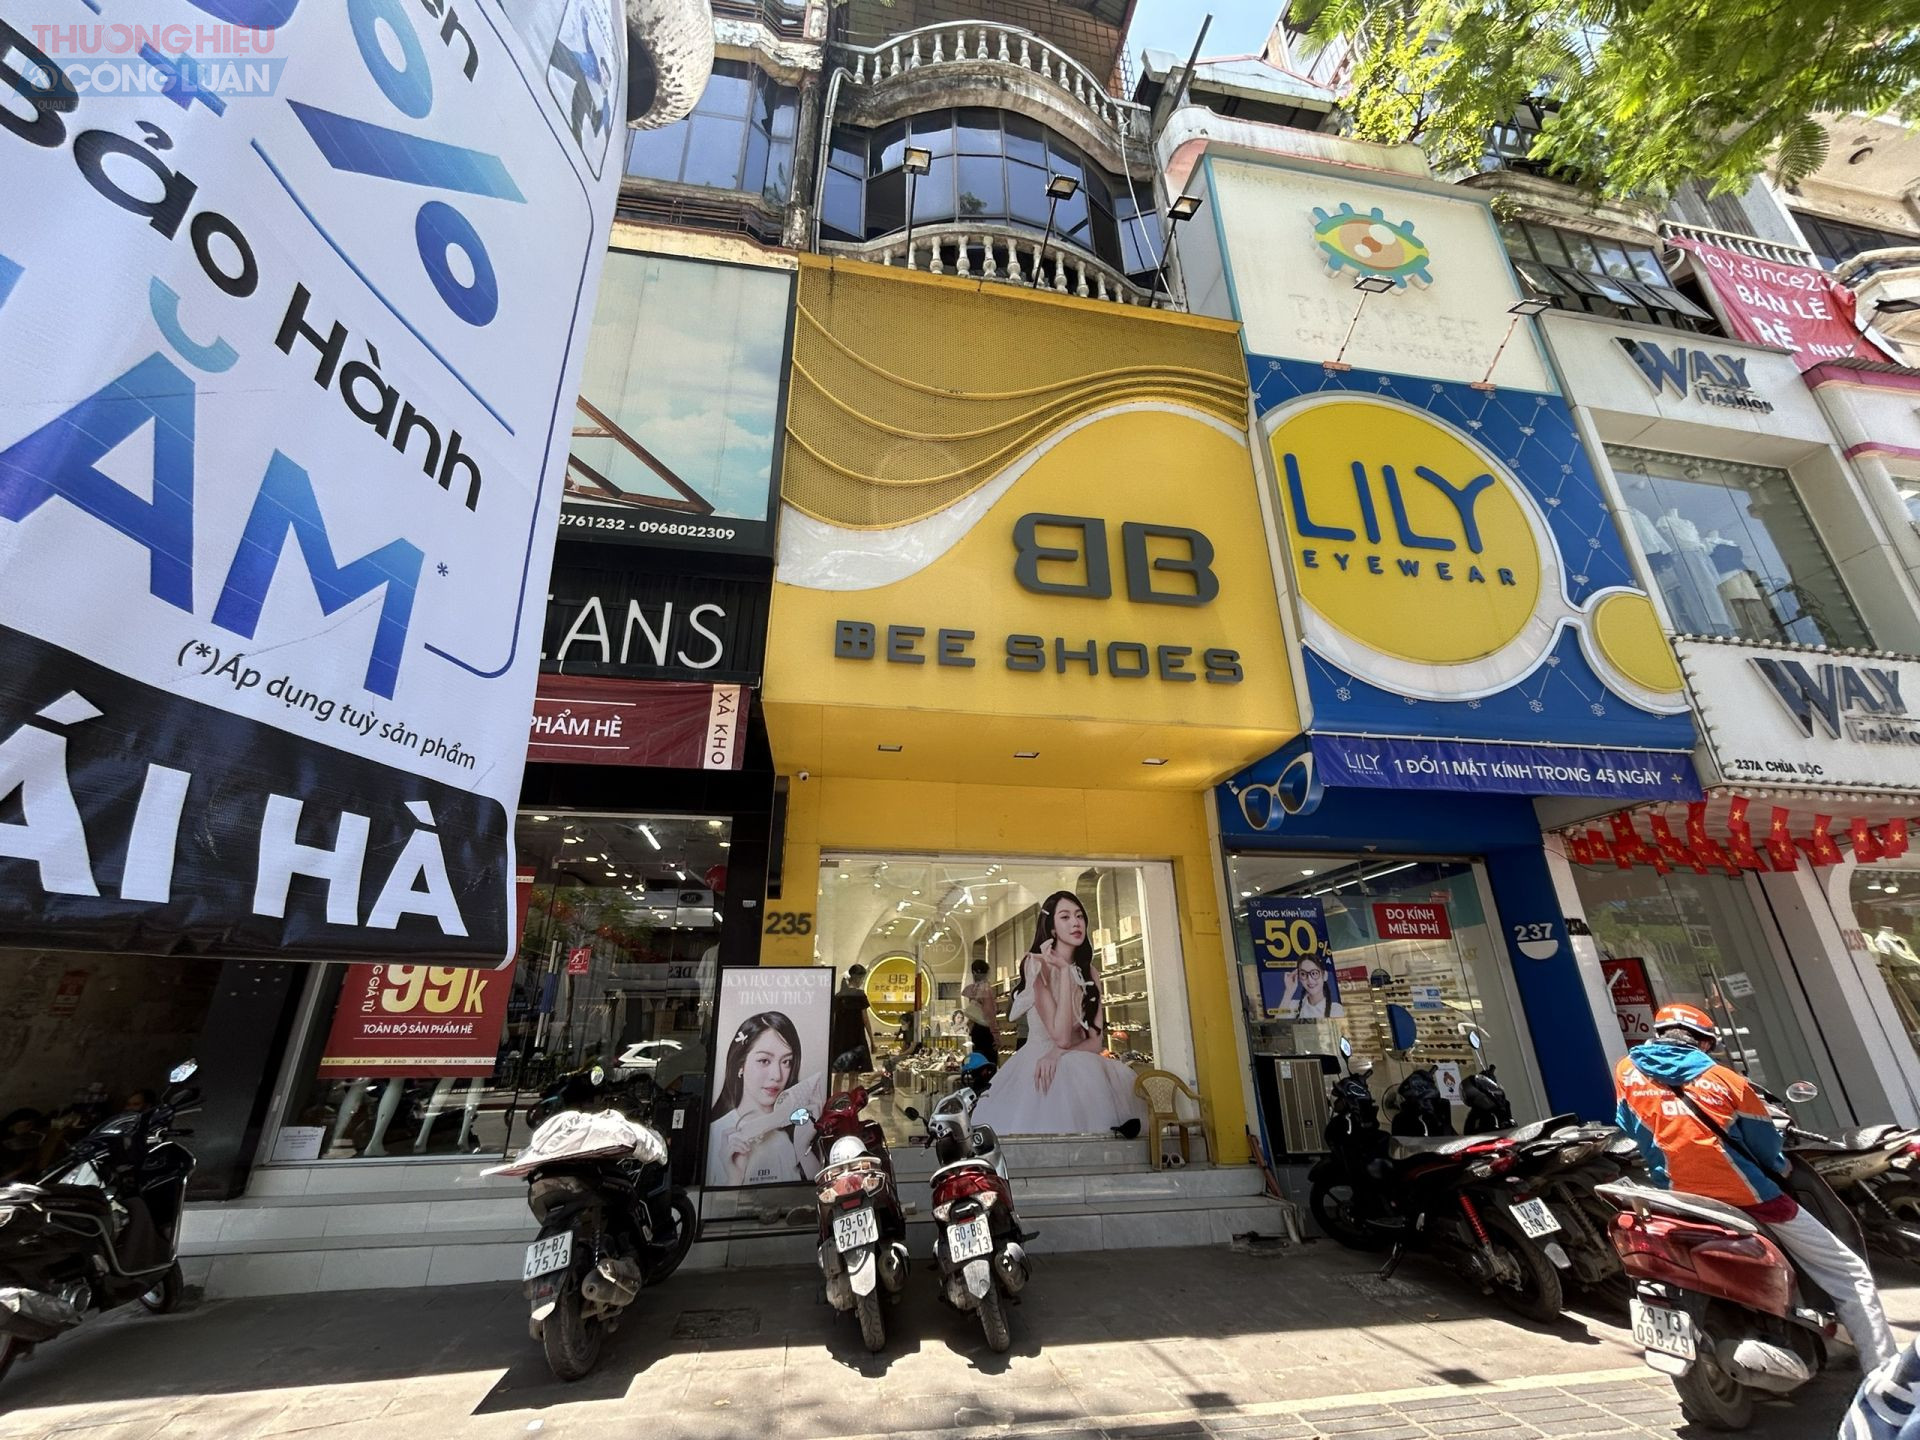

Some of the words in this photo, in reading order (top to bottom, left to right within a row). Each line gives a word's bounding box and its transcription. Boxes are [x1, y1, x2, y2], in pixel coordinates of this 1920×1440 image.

[0, 18, 259, 299] Bảo
[275, 282, 483, 512] Hành
[1610, 336, 1752, 400] WAY
[1283, 453, 1496, 554] LILY
[638, 519, 736, 541] 0968022309
[1302, 549, 1517, 587] EYEWEAR
[541, 594, 727, 670] ANS
[835, 619, 976, 668] BEE
[1004, 632, 1245, 685] SHOES
[717, 691, 736, 717] XẢ
[1746, 656, 1908, 740] WAY
[265, 674, 336, 723] dụng
[380, 716, 419, 748] sản
[419, 732, 477, 771] phẩm
[594, 714, 623, 738] HÈ
[710, 723, 729, 765] KHO
[1343, 752, 1381, 771] LILY
[1394, 759, 1404, 774] 1
[1406, 755, 1440, 774] ĐỔI
[1441, 760, 1450, 775] 1
[1452, 757, 1488, 777] MẮT
[1491, 760, 1533, 780] KÍNH
[1533, 765, 1591, 783] TRONG
[1595, 768, 1617, 783] 45
[1617, 767, 1662, 785] NGÀY
[1735, 759, 1763, 771] 237A
[1765, 759, 1797, 773] CHÙA
[252, 793, 470, 937] HÀ
[764, 911, 812, 936] 235
[1386, 909, 1405, 920] ĐO
[1407, 906, 1436, 919] KÍNH
[1388, 920, 1418, 935] MIỄN
[1420, 919, 1440, 934] PHÍ
[1513, 922, 1553, 941] 237
[363, 1022, 391, 1034] TOÀN
[392, 1022, 408, 1036] BỘ
[409, 1021, 430, 1034] SẢN
[431, 1020, 459, 1035] PHẨM
[460, 1021, 474, 1034] HÈ
[840, 1207, 869, 1232] 29-G1
[954, 1221, 983, 1242] 60-B8
[534, 1235, 566, 1259] 17-B7
[526, 1249, 568, 1277] 475.73
[1639, 1306, 1683, 1332] 29-Y3
[1637, 1325, 1689, 1354] 098.29
